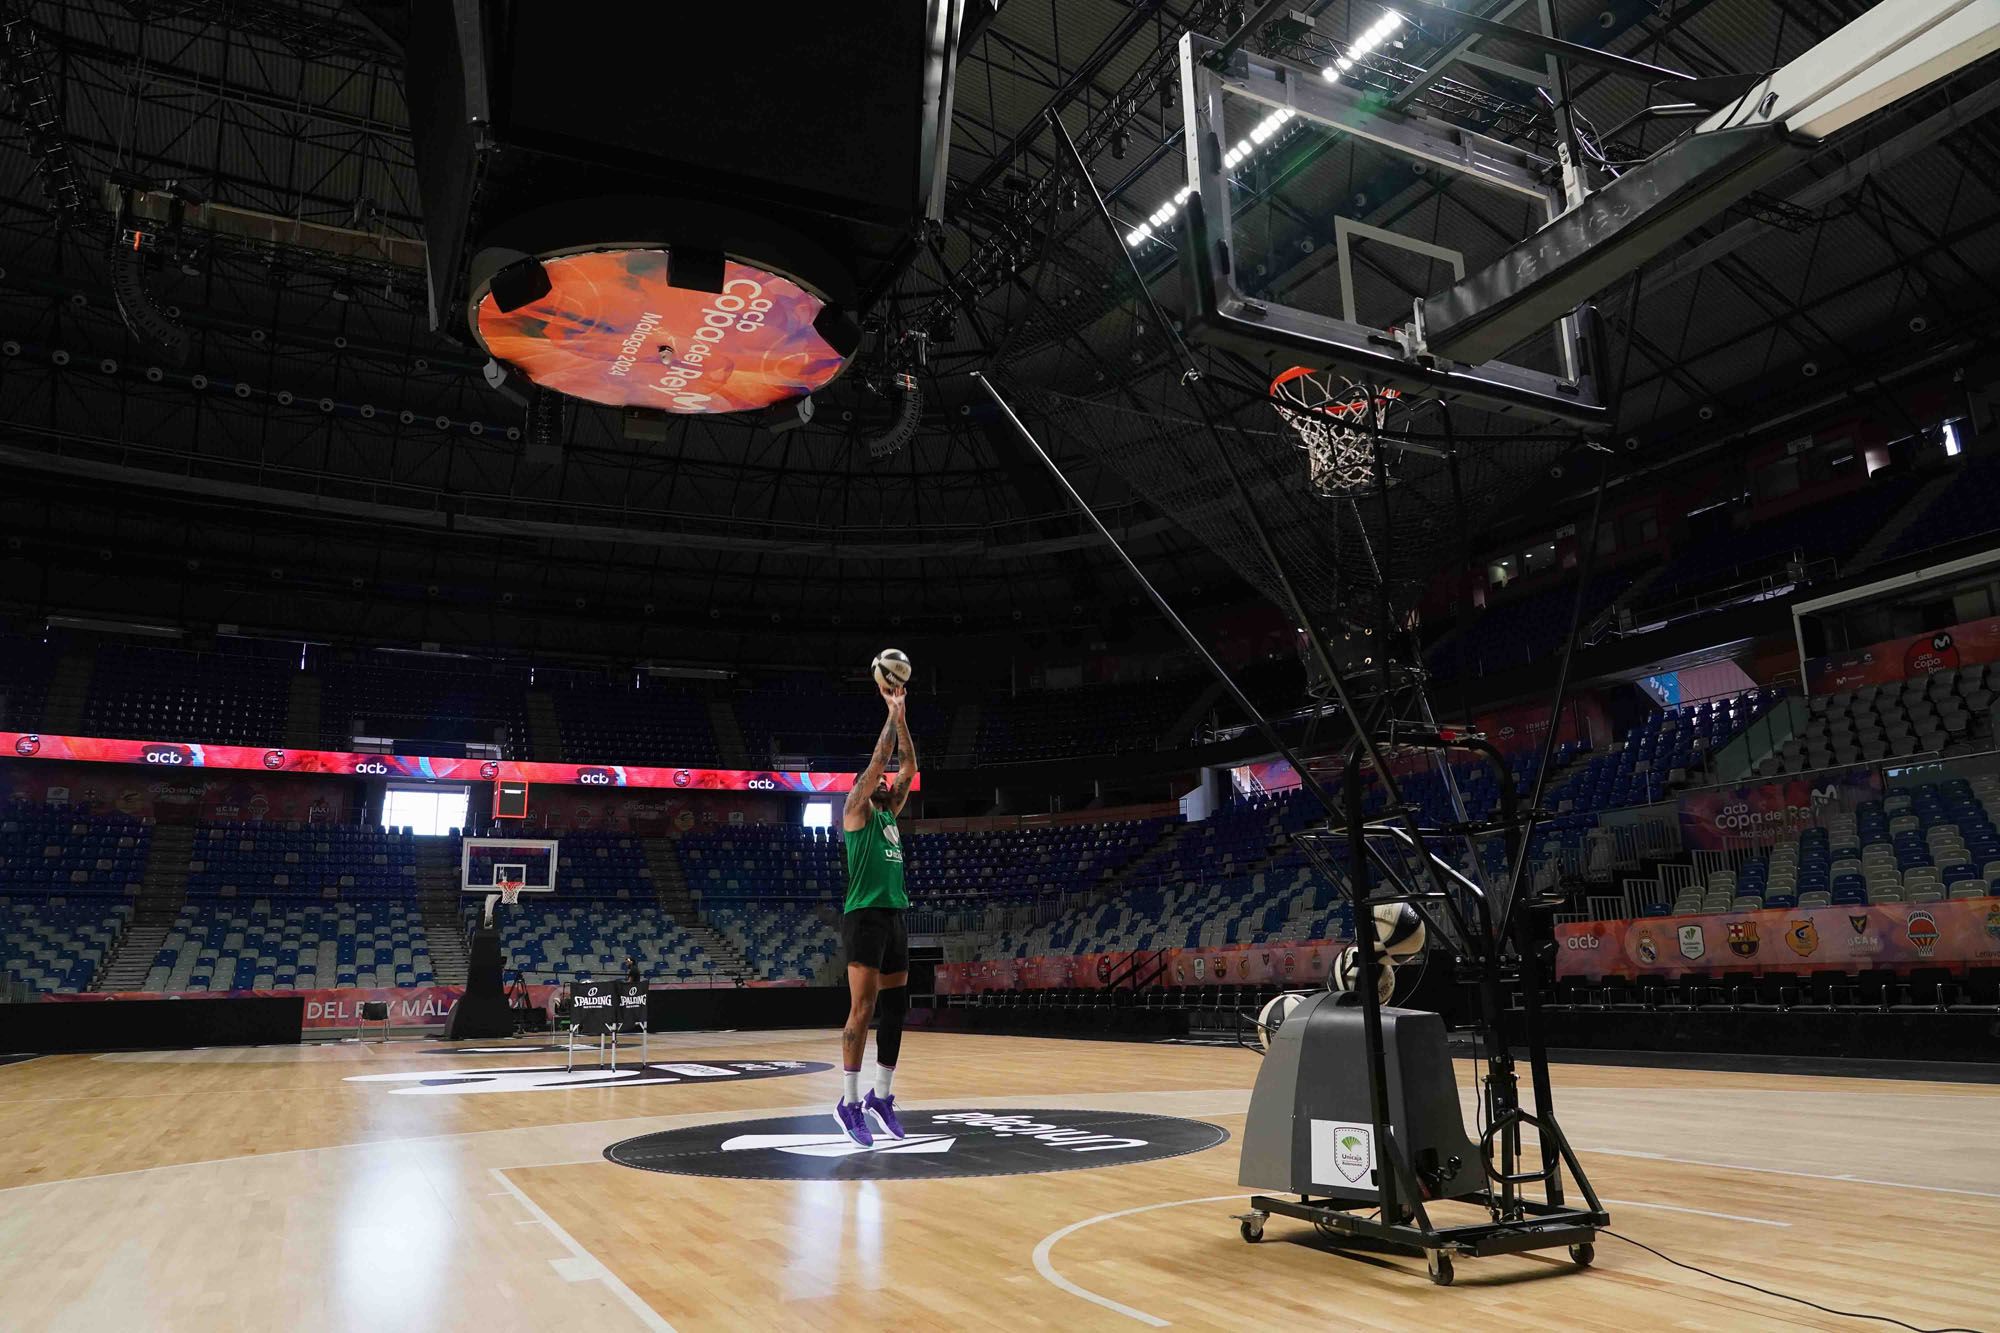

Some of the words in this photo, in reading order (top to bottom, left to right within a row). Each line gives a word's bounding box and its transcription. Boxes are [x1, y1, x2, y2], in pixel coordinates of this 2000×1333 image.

[695, 279, 763, 344] Copa
[735, 298, 773, 333] acb
[681, 344, 712, 369] del
[608, 356, 638, 377] 2024
[649, 365, 704, 396] Rey
[1913, 657, 1941, 670] Copa
[147, 748, 182, 765] acb
[355, 761, 388, 776] acb
[581, 771, 609, 785] acb
[749, 777, 775, 791] acb
[1723, 801, 1749, 816] acb
[1714, 809, 1763, 831] Copa
[1567, 933, 1600, 950] acb
[574, 994, 613, 1008] SPALDING
[619, 993, 647, 1008] SPALDING
[307, 1001, 349, 1020] DEL
[355, 1000, 397, 1019] RY
[931, 1112, 1149, 1152] Unicaja
[1341, 1153, 1363, 1162] Unicaja
